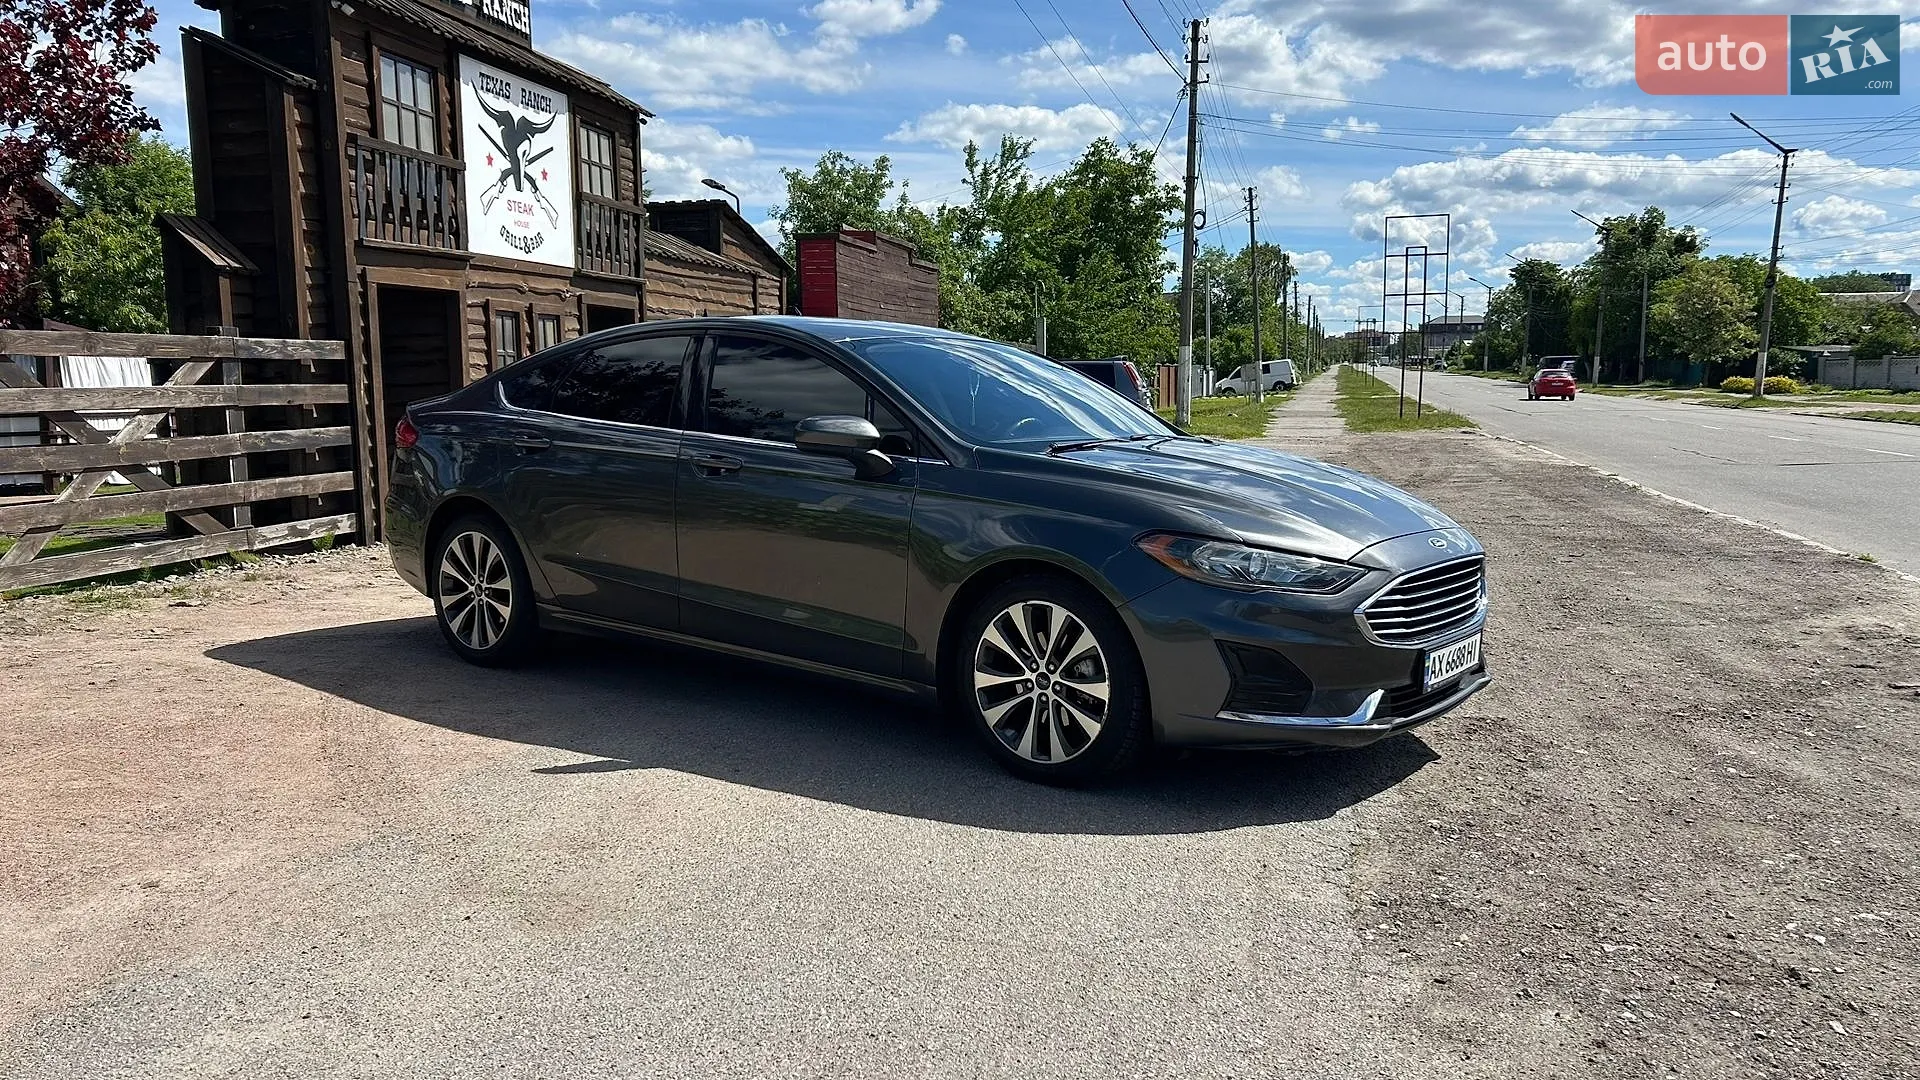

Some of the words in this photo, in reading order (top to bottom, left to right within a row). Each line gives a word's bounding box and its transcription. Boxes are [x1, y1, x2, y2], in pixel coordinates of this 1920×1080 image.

[483, 0, 530, 35] RANCH
[478, 71, 512, 99] TEXAS
[520, 87, 552, 114] RANCH
[506, 199, 535, 216] STEAK
[513, 218, 530, 229] HOUSE
[1429, 653, 1445, 681] AX
